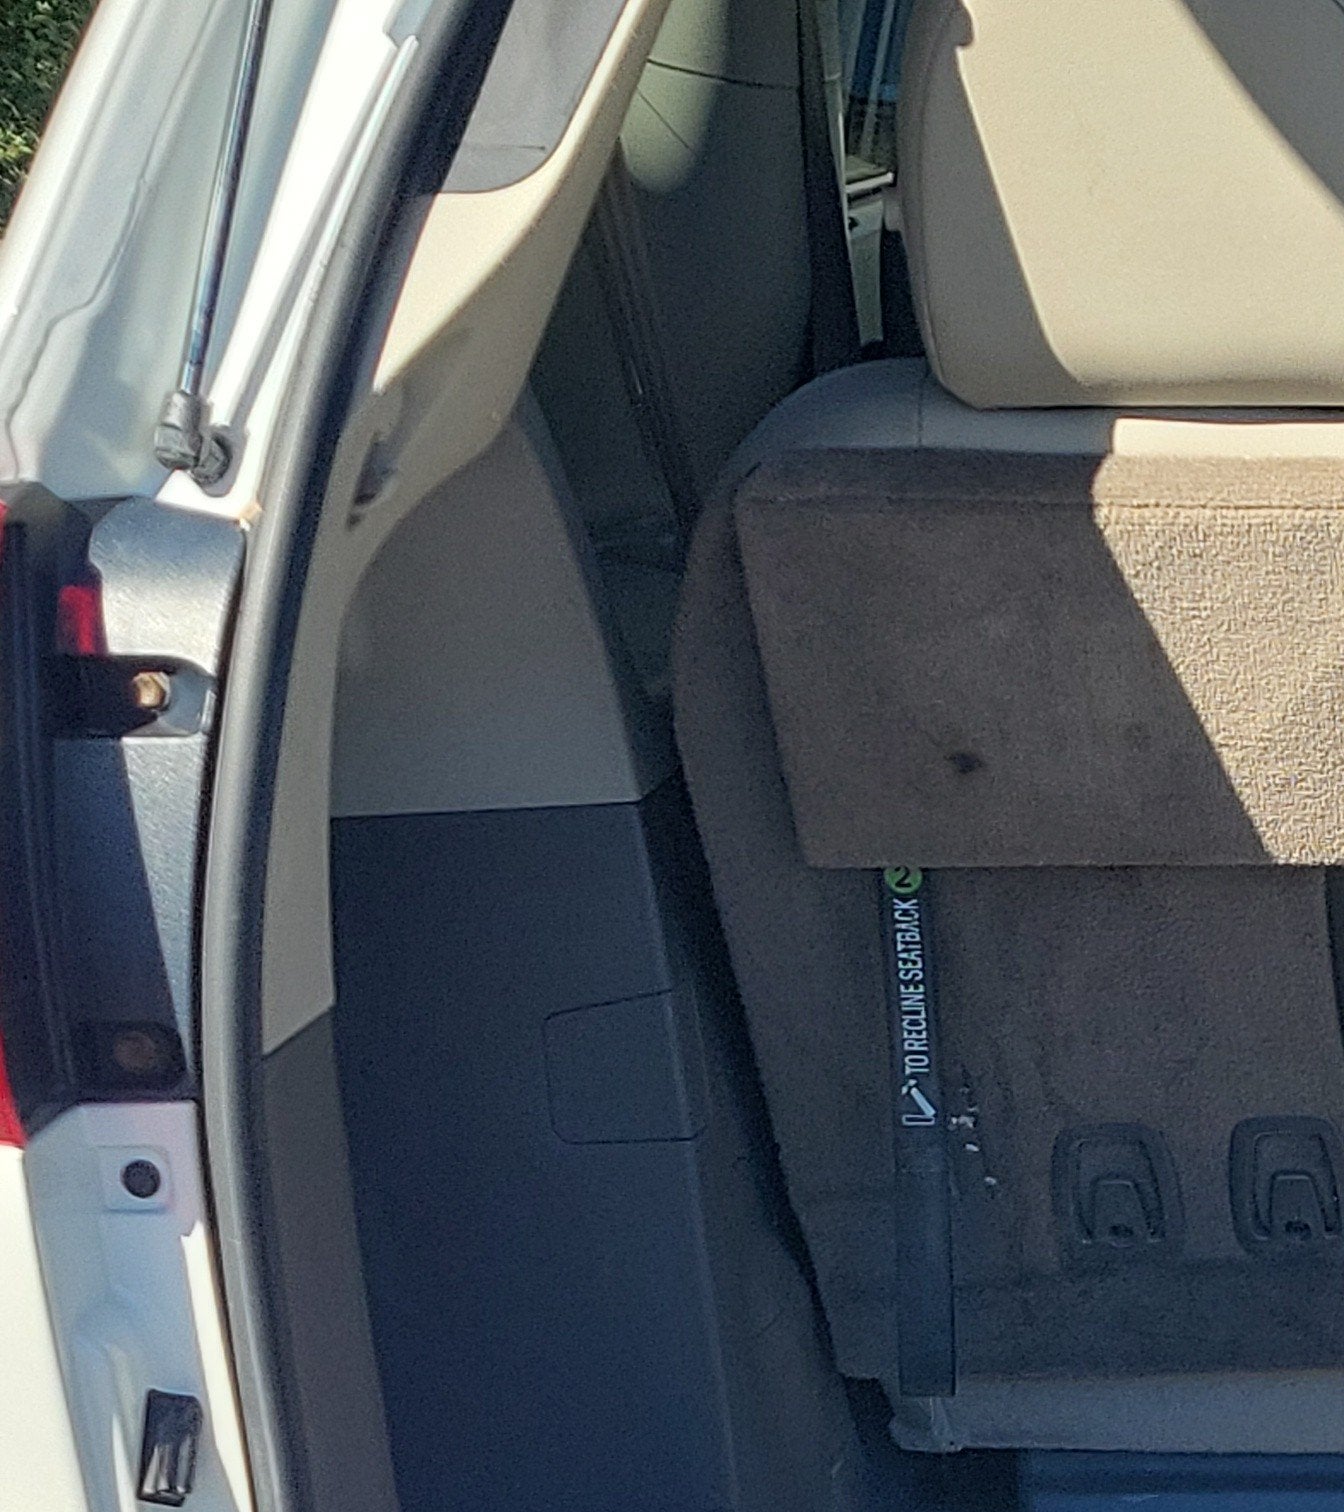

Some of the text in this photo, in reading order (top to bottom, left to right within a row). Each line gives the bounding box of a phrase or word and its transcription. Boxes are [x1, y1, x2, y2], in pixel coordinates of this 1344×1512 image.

[894, 866, 912, 888] 2
[893, 898, 930, 1075] TO RECLINE SEATBACK
